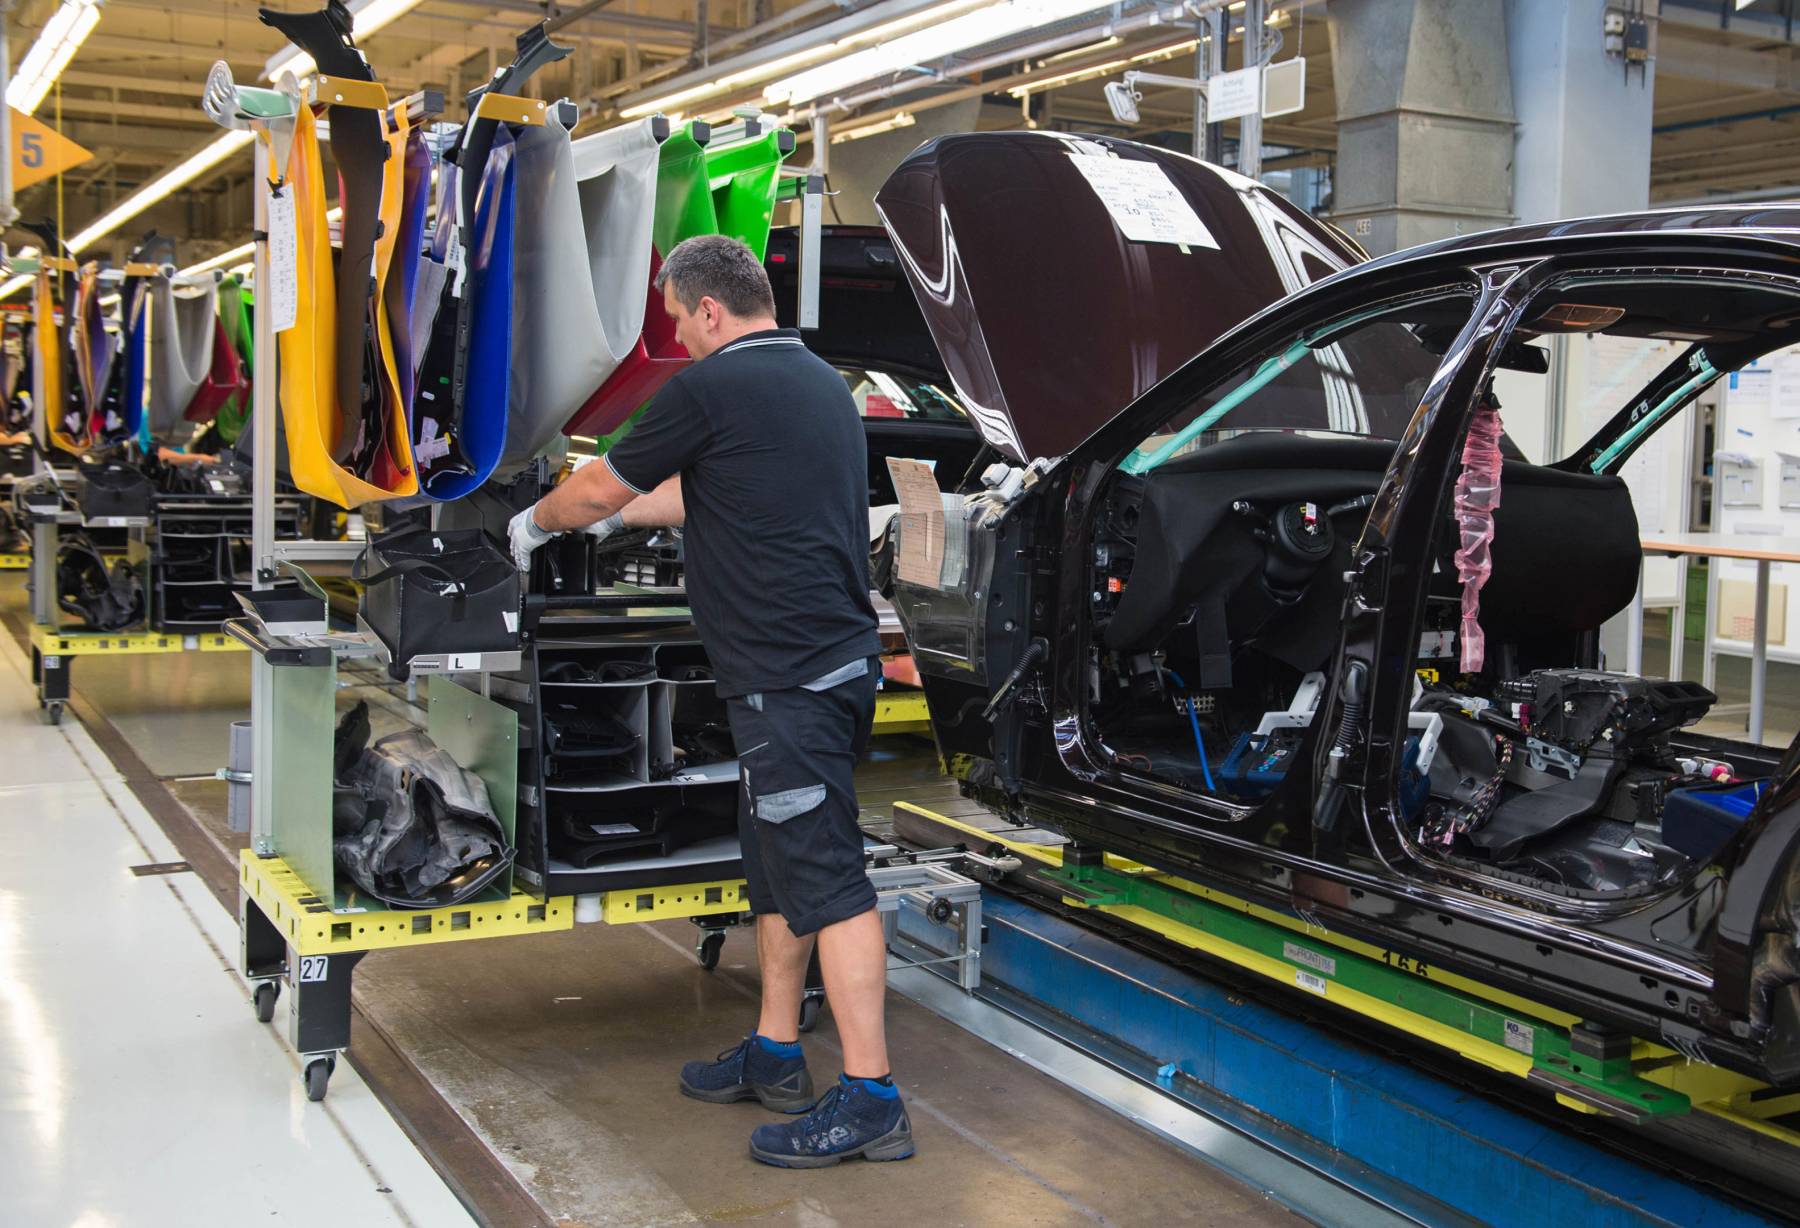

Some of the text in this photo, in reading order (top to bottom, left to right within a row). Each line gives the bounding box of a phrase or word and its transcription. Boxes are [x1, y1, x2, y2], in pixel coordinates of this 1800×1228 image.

[22, 133, 43, 168] 5
[455, 657, 464, 669] L
[302, 958, 326, 980] 27
